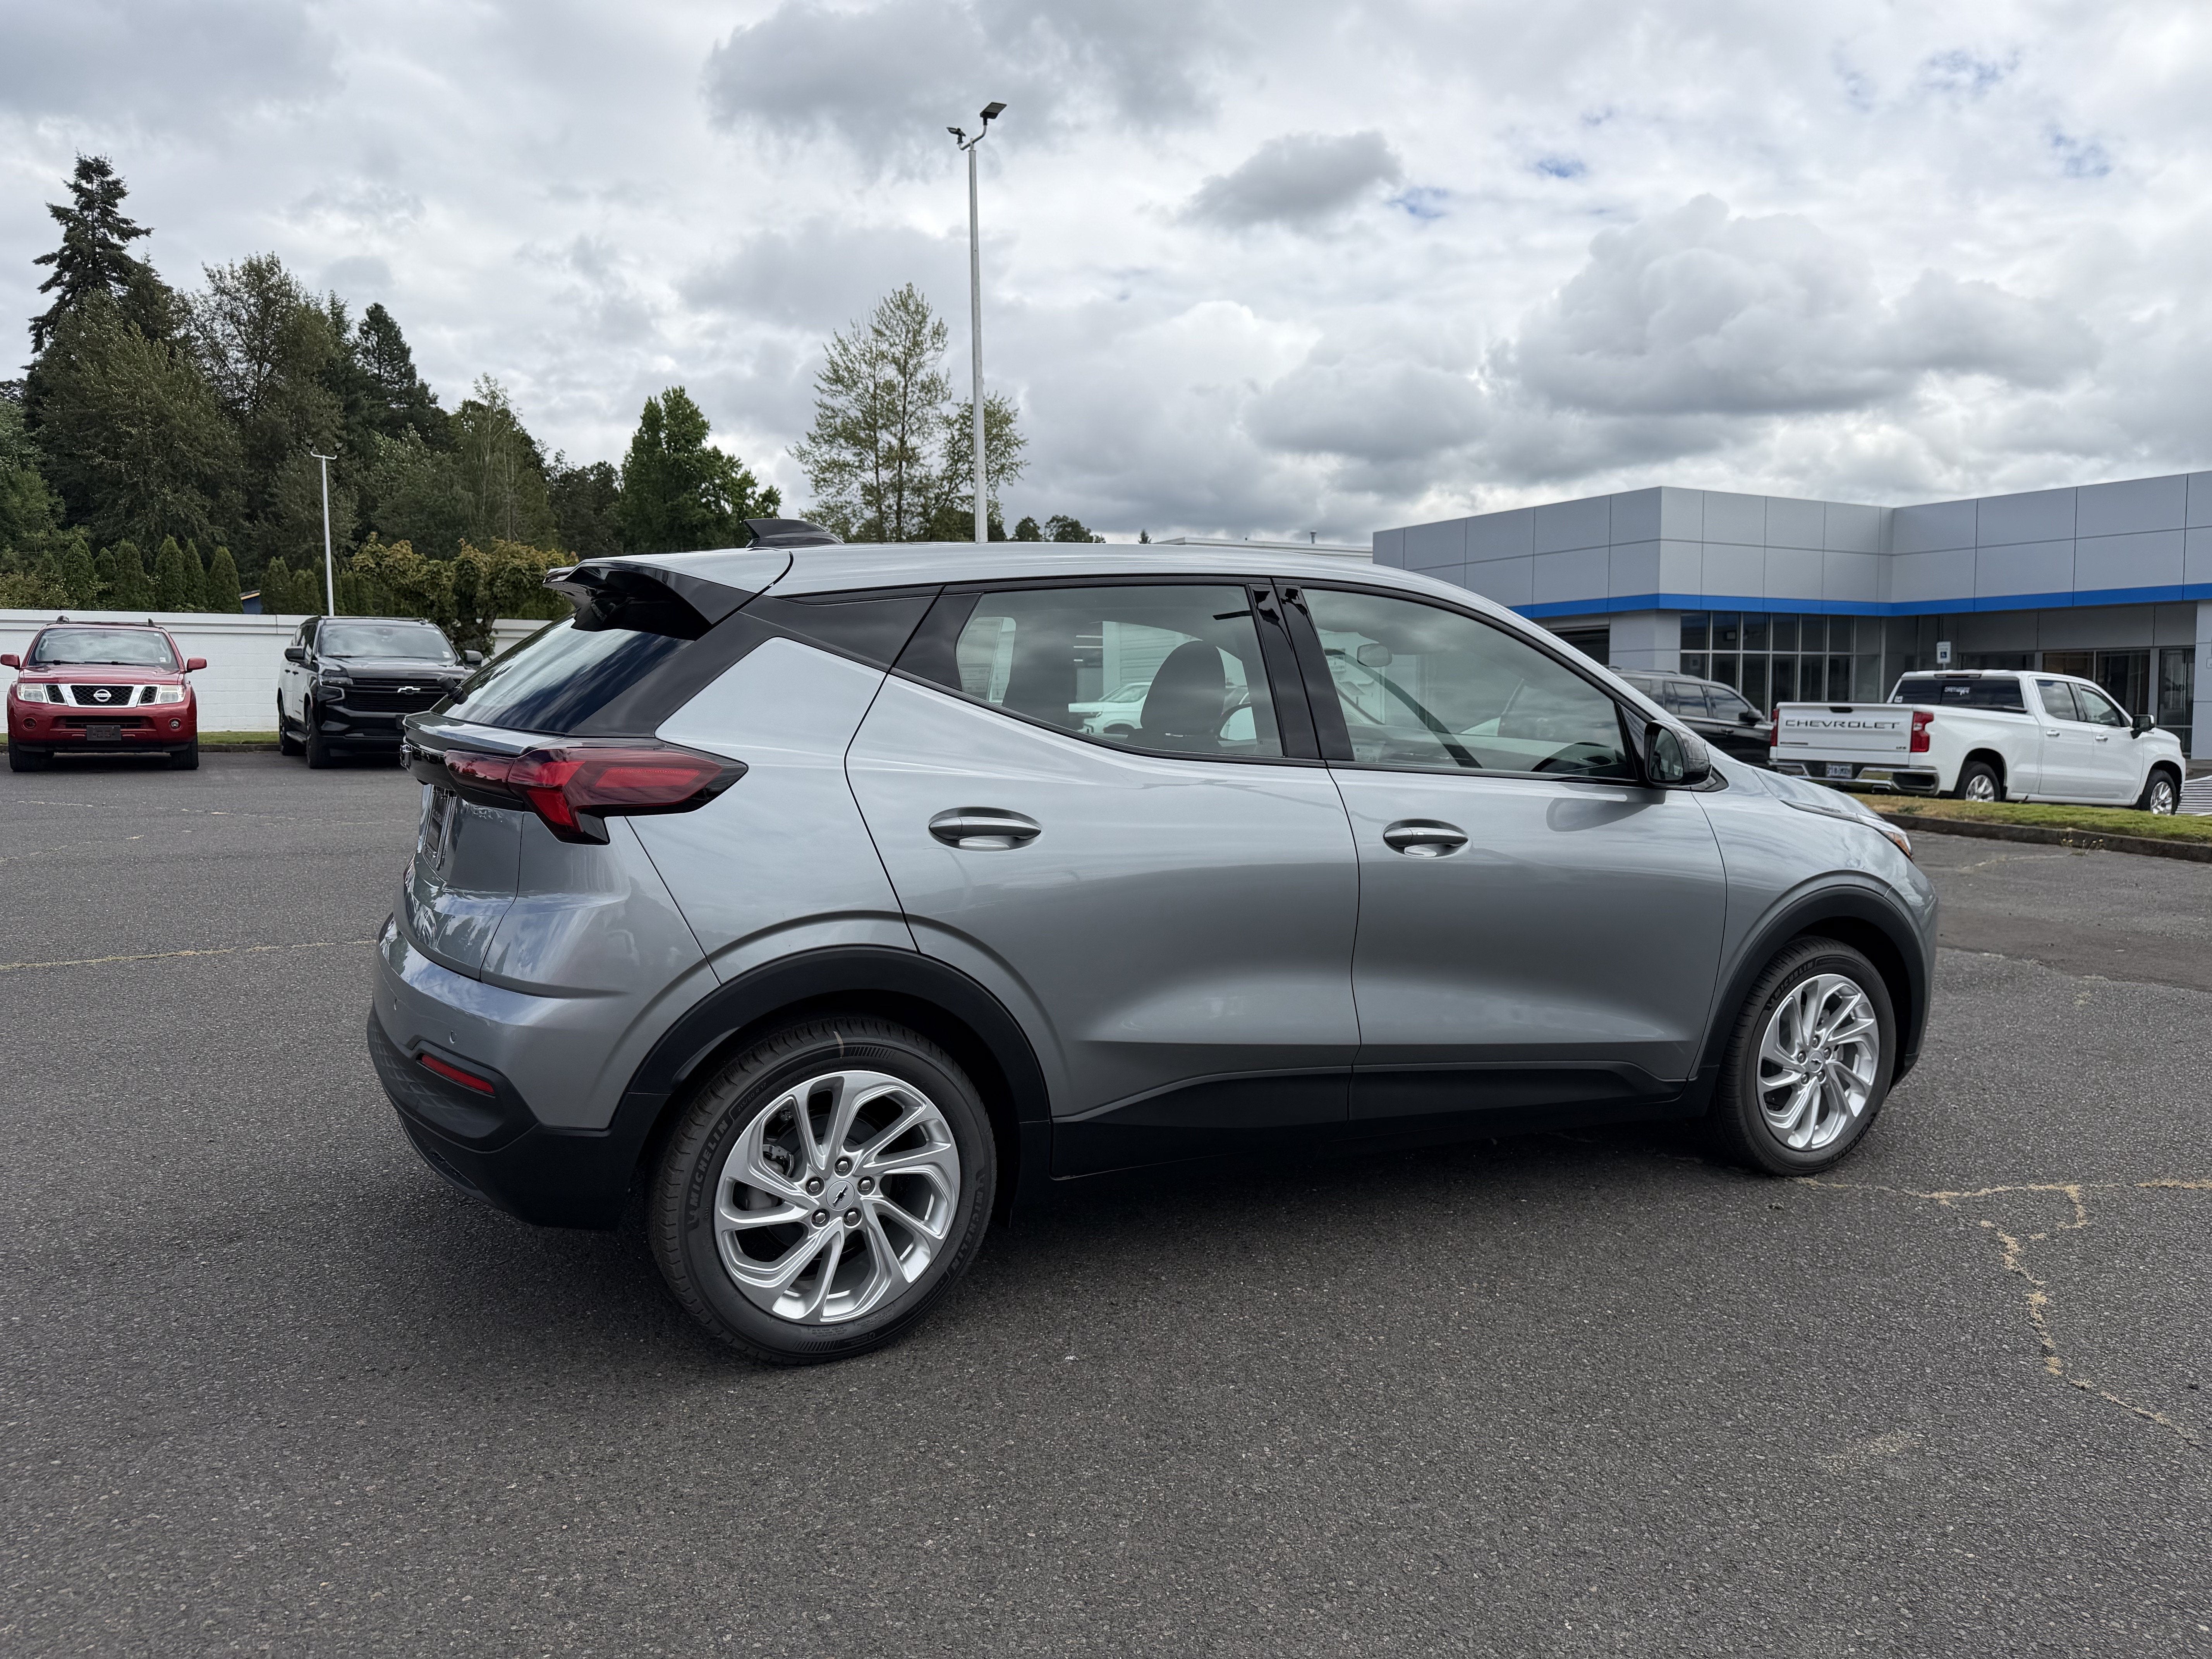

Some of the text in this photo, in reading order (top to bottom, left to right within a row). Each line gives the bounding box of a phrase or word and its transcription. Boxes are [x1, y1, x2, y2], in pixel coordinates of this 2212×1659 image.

[1785, 720, 1900, 729] CHEVROLET
[737, 1093, 754, 1111] 215/50
[690, 1120, 728, 1206] MICHELIN
[951, 1191, 984, 1271] MICHELIN
